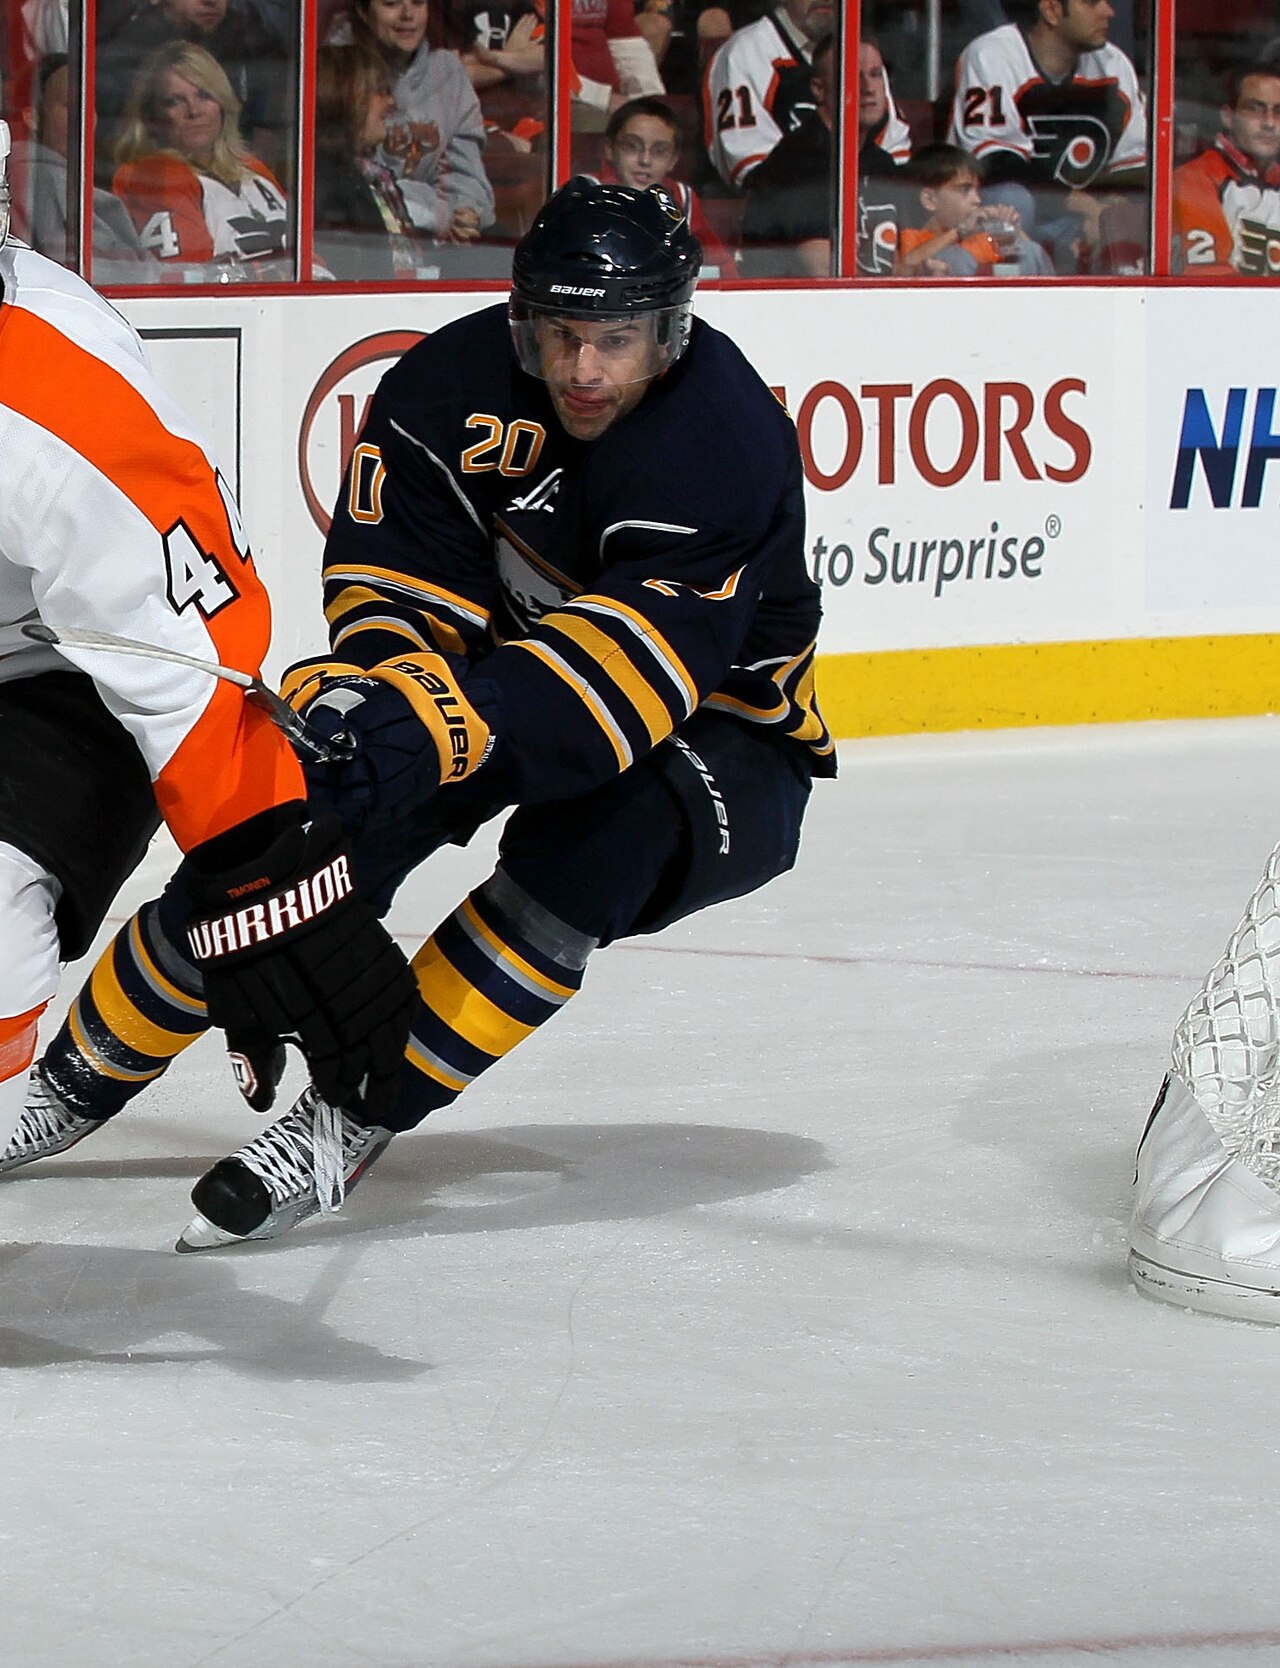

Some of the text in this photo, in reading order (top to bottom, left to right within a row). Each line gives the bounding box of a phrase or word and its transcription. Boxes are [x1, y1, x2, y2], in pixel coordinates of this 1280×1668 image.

[718, 85, 757, 130] 21
[963, 85, 1007, 127] 21
[139, 210, 181, 258] 4
[1186, 228, 1217, 264] 2
[549, 284, 606, 298] BAUER
[461, 412, 547, 478] 20
[770, 378, 1092, 491] OTORS
[812, 536, 854, 587] to
[382, 660, 470, 781] BAUER
[187, 855, 354, 960] WARRIOR
[226, 876, 272, 899] TIMONEN
